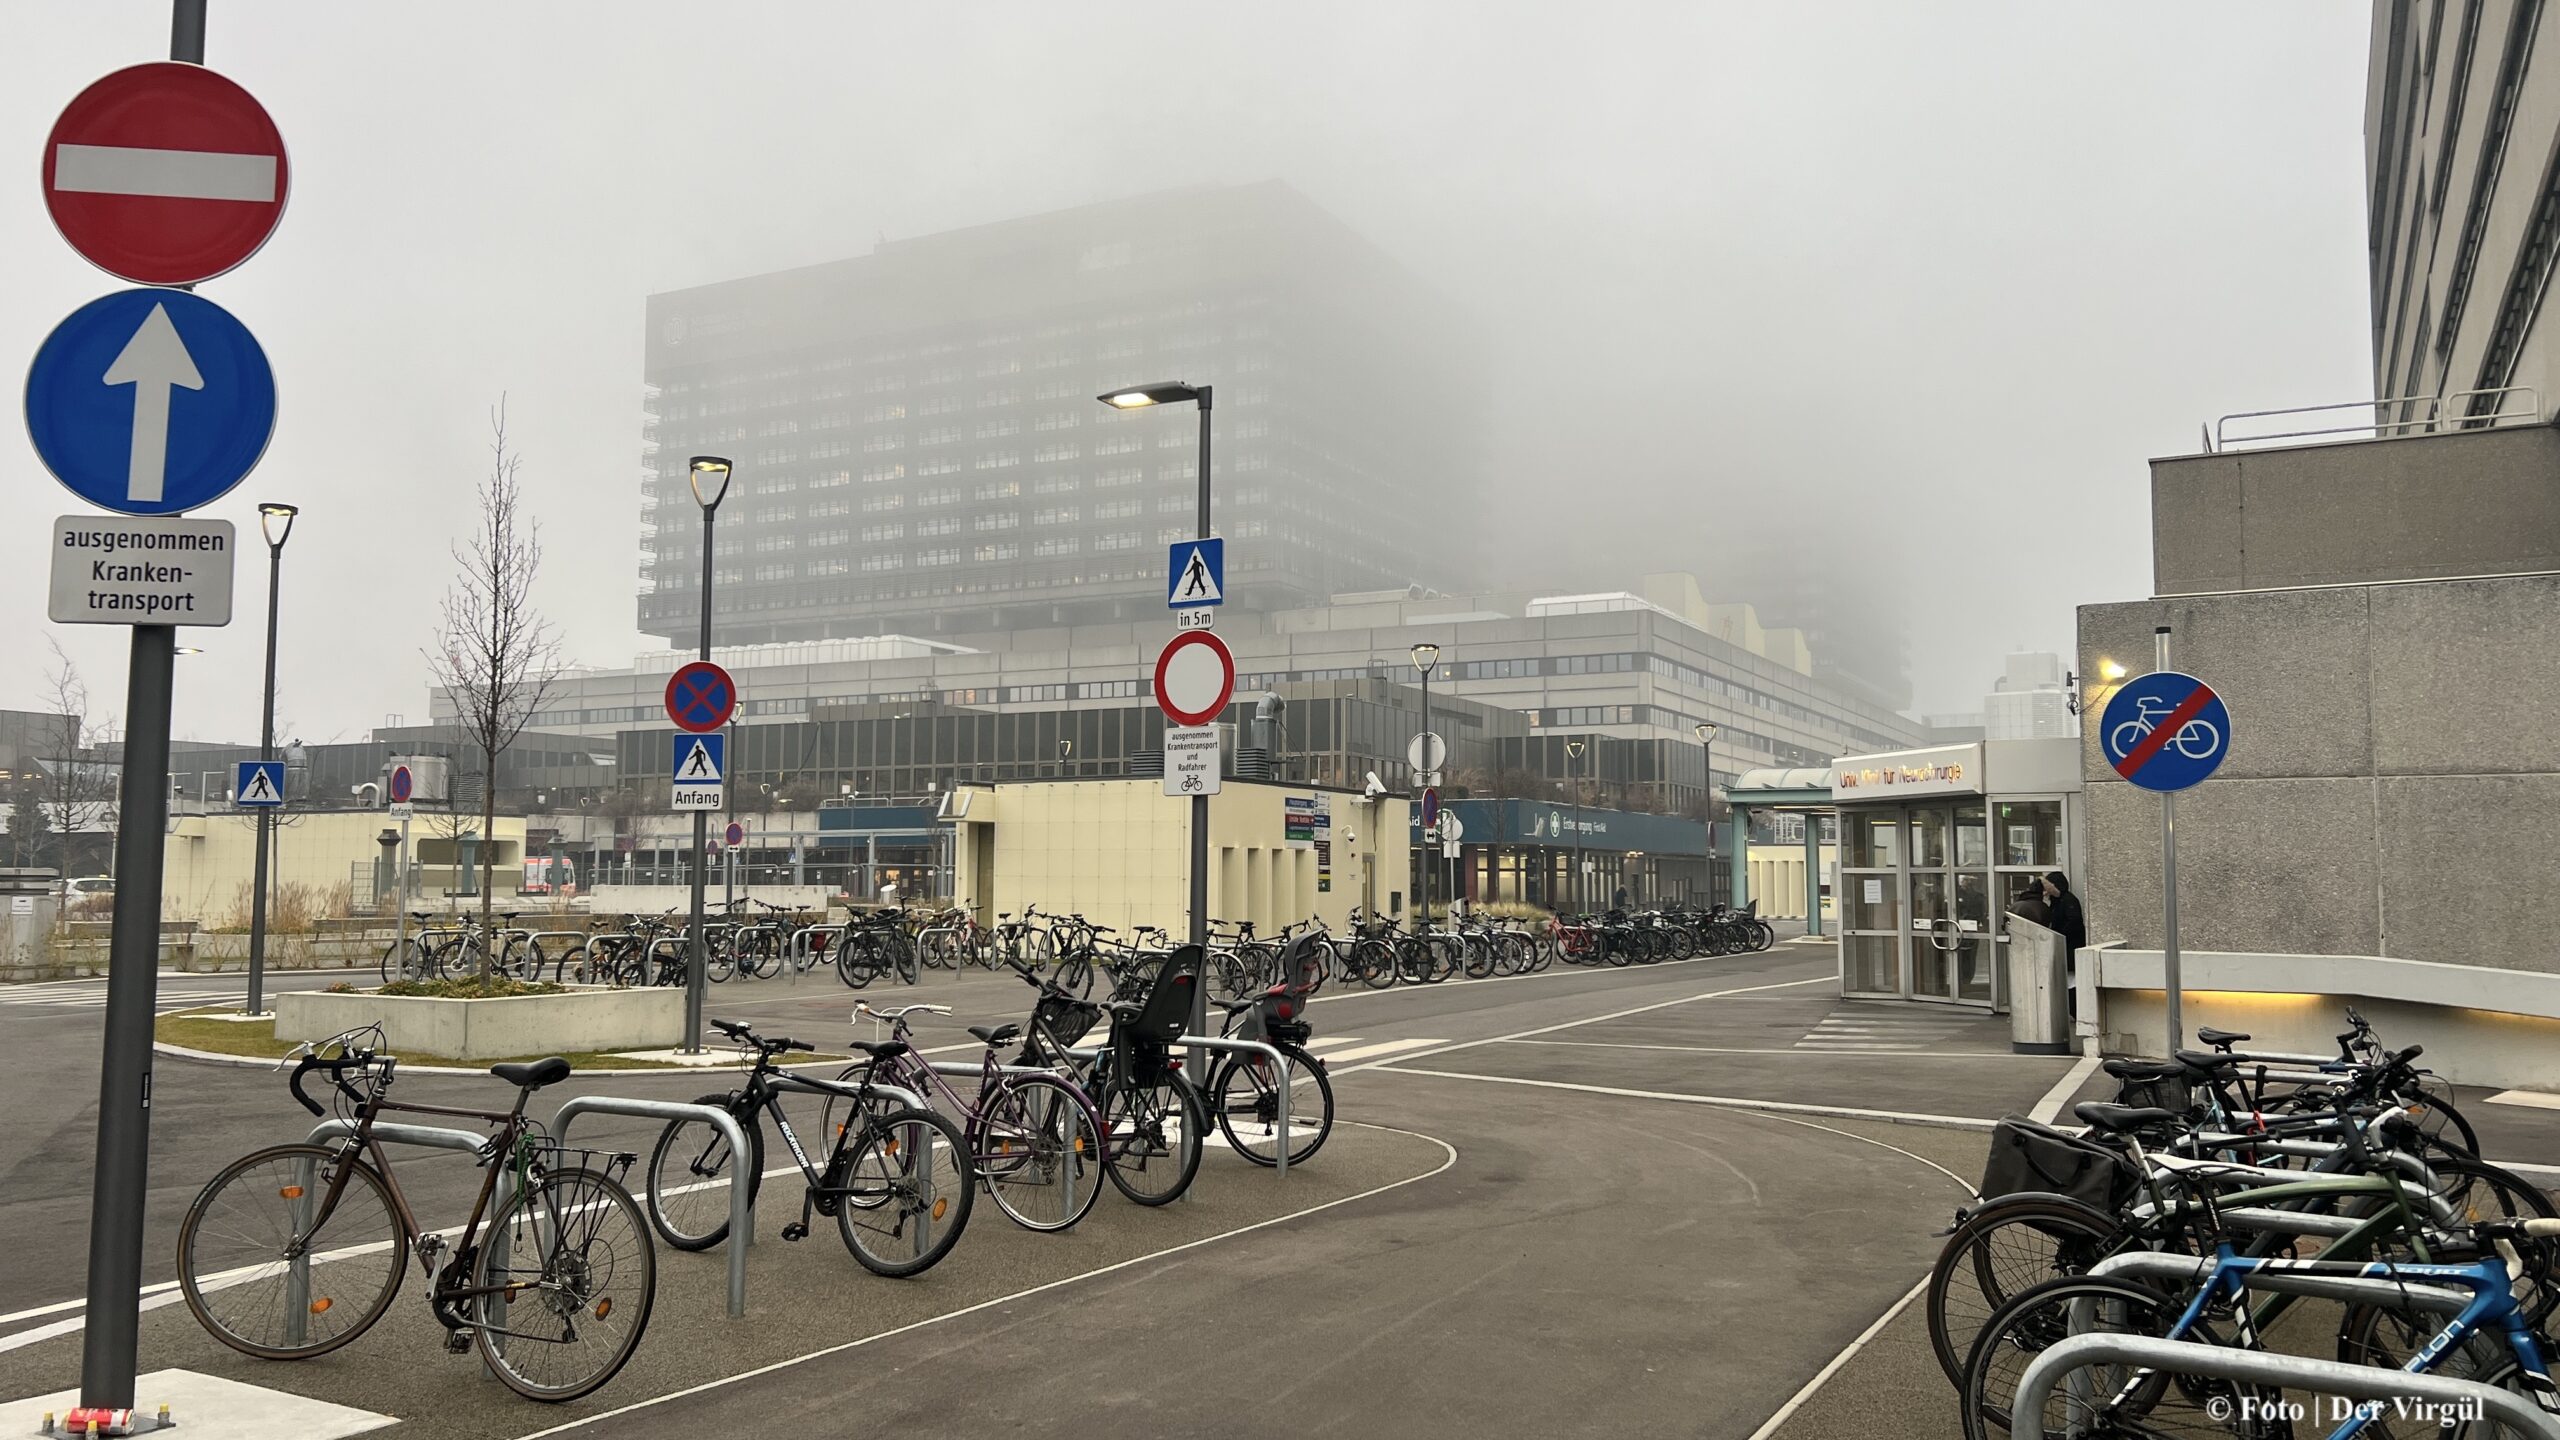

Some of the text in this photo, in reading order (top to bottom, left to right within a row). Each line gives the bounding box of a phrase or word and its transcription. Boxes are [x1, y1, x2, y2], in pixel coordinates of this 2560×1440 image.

[64, 531, 224, 553] ausgenommen
[92, 560, 193, 583] Kranken-
[88, 590, 195, 615] transport
[1180, 611, 1211, 626] in 5m
[1171, 731, 1214, 741] ausgenommen
[1167, 741, 1218, 751] Krankentransport
[1186, 752, 1198, 760] und
[1178, 763, 1207, 771] Radfahrer
[1839, 770, 1858, 788] Univ.
[1883, 767, 1895, 784] für
[675, 790, 720, 807] Anfang
[390, 807, 412, 818] Anfang
[779, 1121, 810, 1168] ROCKRIDER
